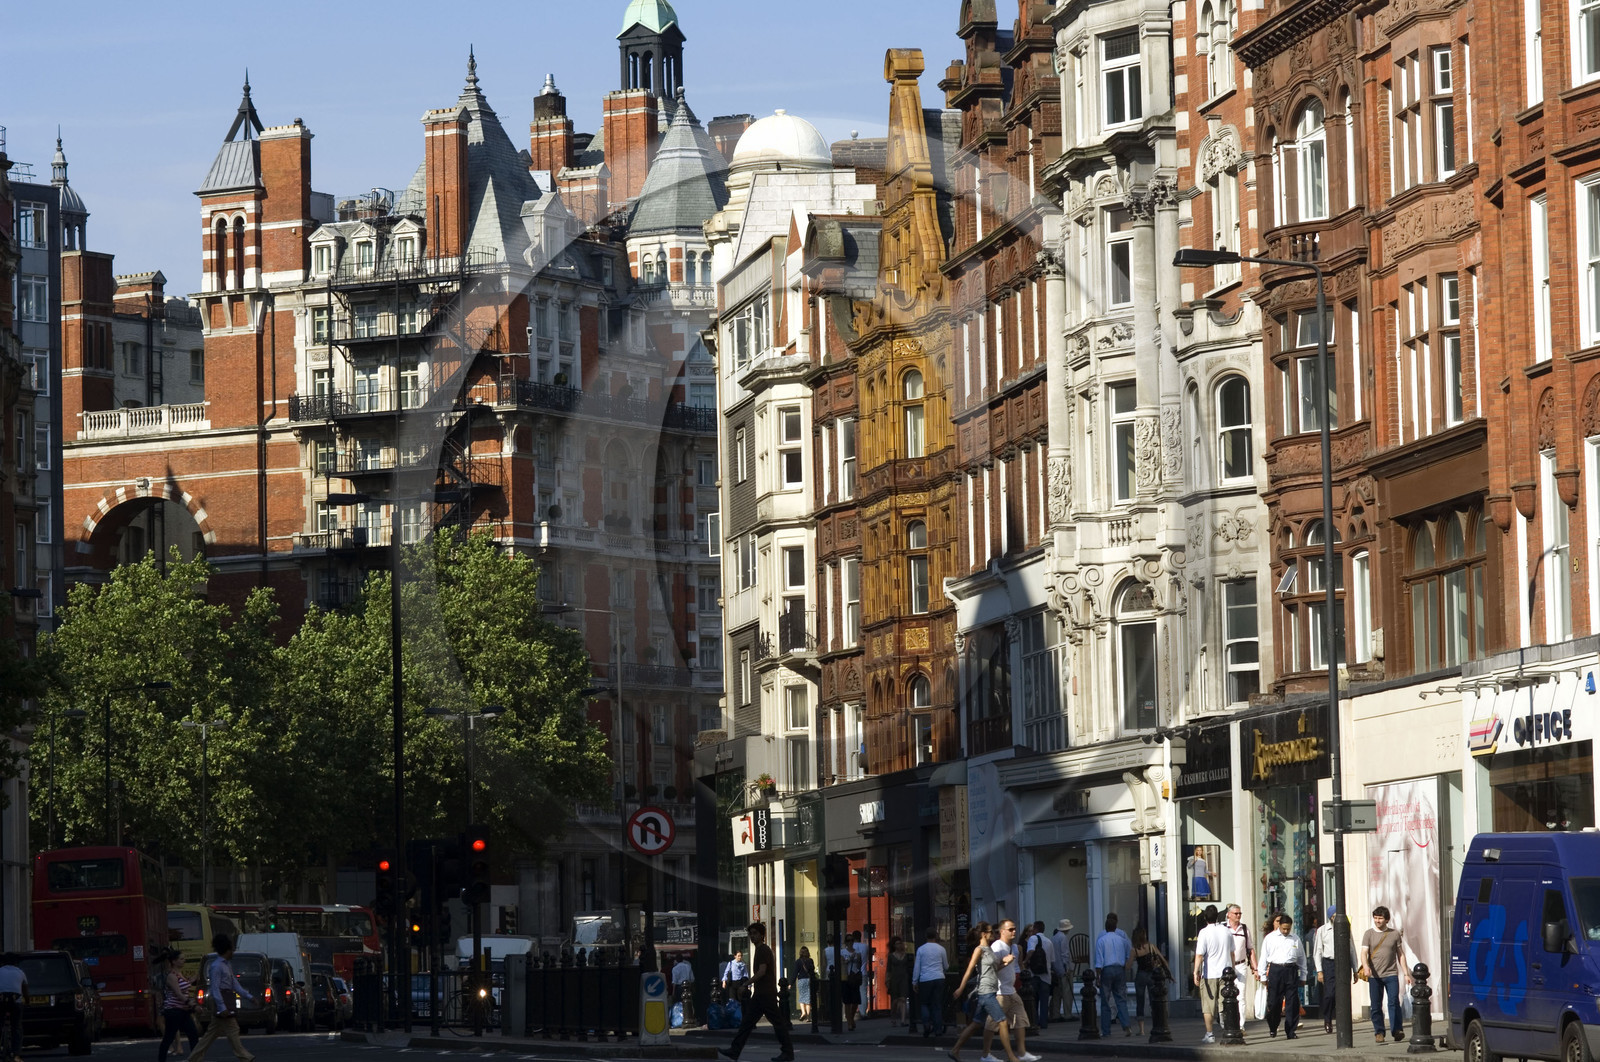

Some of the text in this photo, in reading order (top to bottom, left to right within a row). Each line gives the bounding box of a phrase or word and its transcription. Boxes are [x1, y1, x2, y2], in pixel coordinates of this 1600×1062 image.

[1514, 709, 1572, 747] OFFICE
[757, 810, 767, 849] HOBBS
[79, 916, 97, 927] 414
